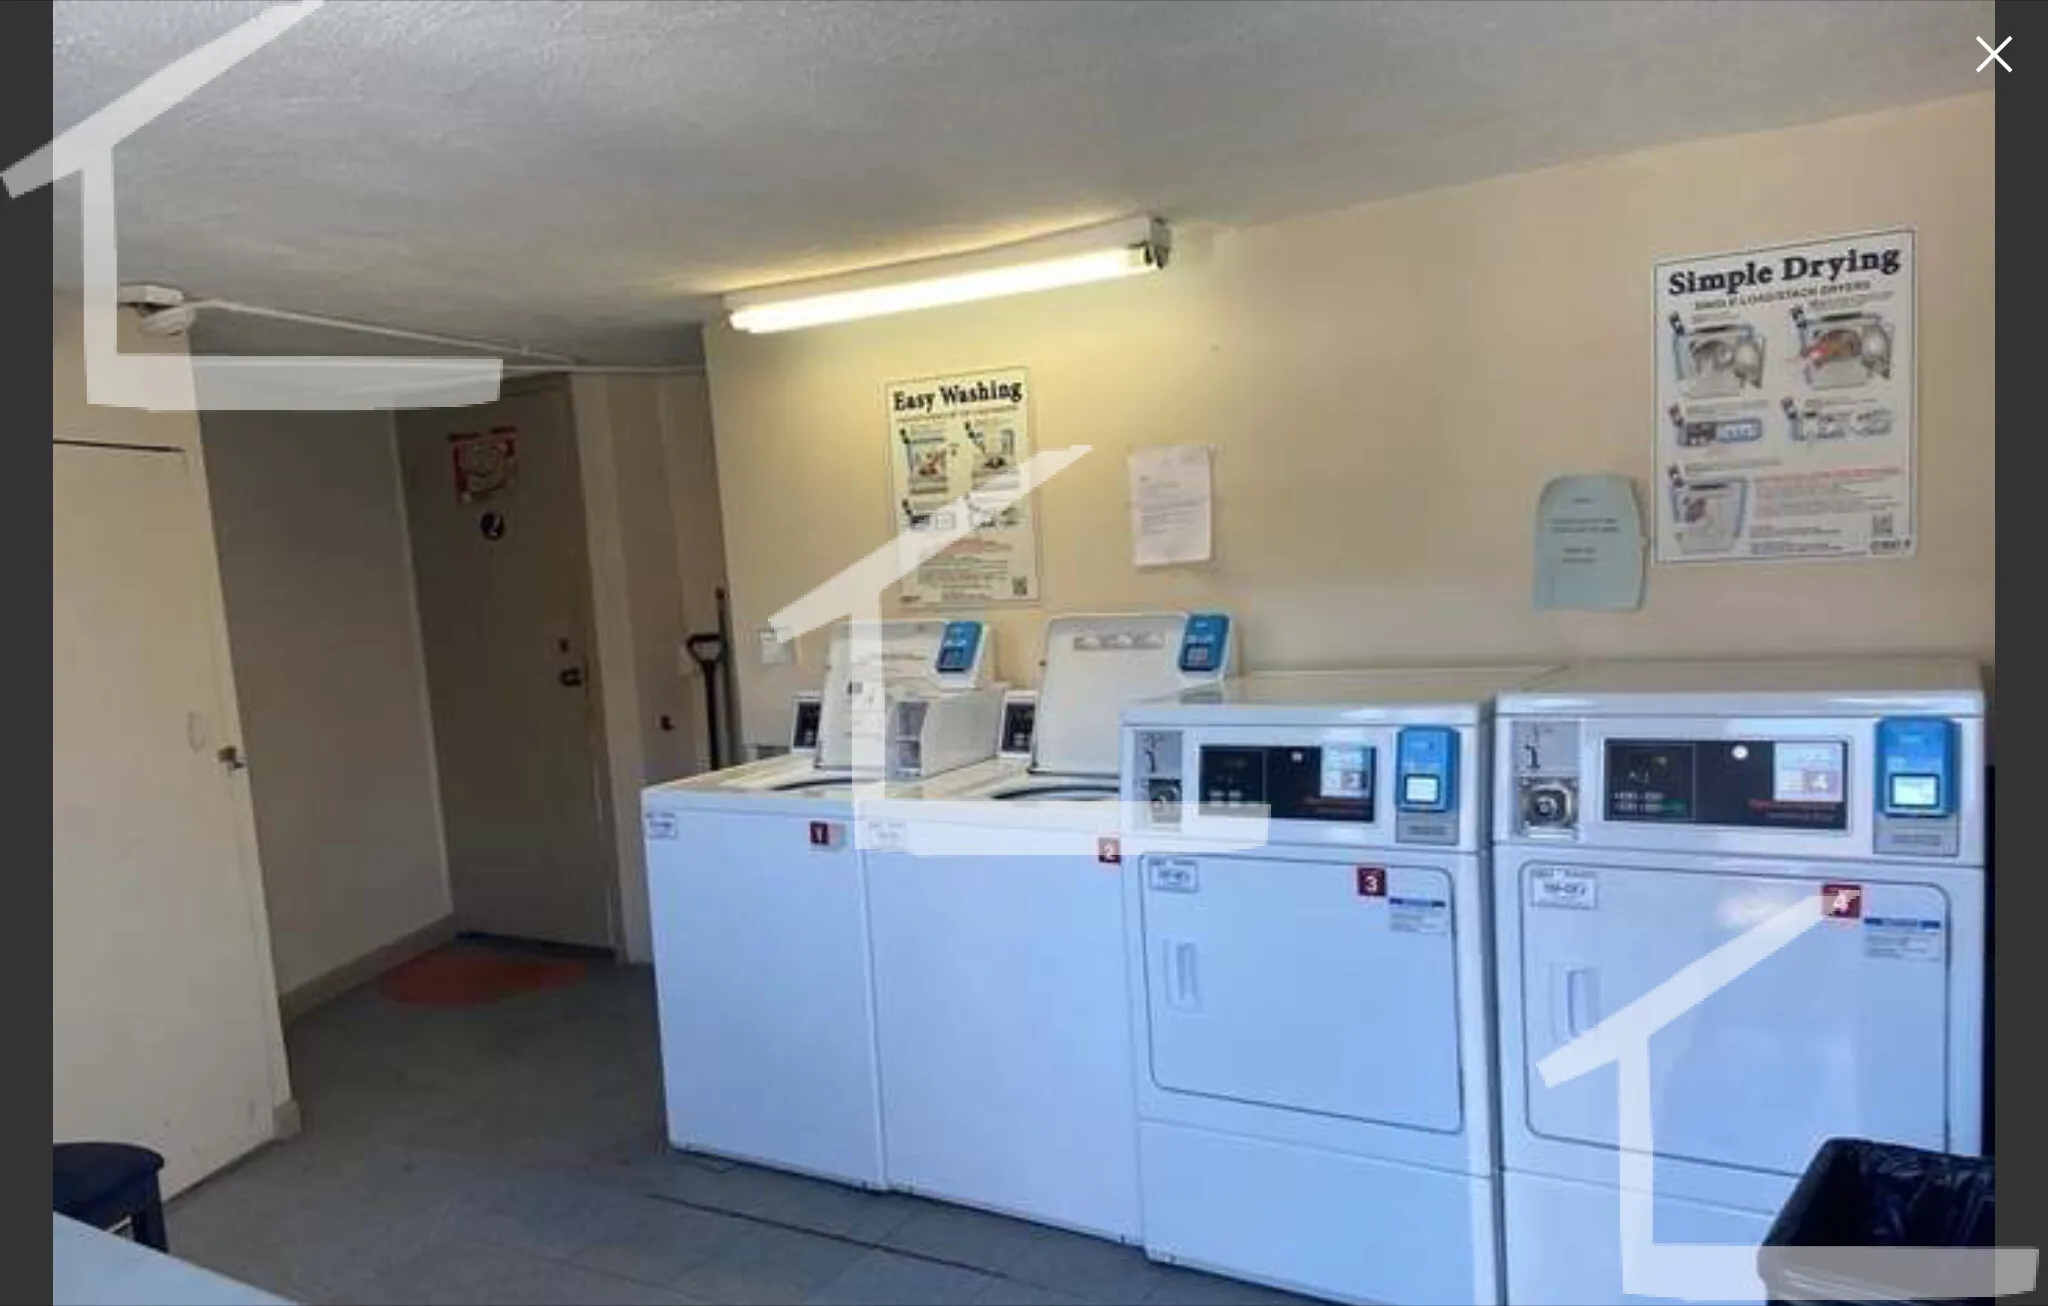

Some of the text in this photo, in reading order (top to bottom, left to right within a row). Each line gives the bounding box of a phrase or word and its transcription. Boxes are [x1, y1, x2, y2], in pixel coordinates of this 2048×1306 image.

[1669, 248, 1901, 295] Simple Drying
[893, 390, 935, 416] Easy
[940, 380, 1023, 405] Washing
[1103, 843, 1117, 860] 2
[1363, 875, 1378, 891] 3
[1833, 892, 1849, 911] 4
